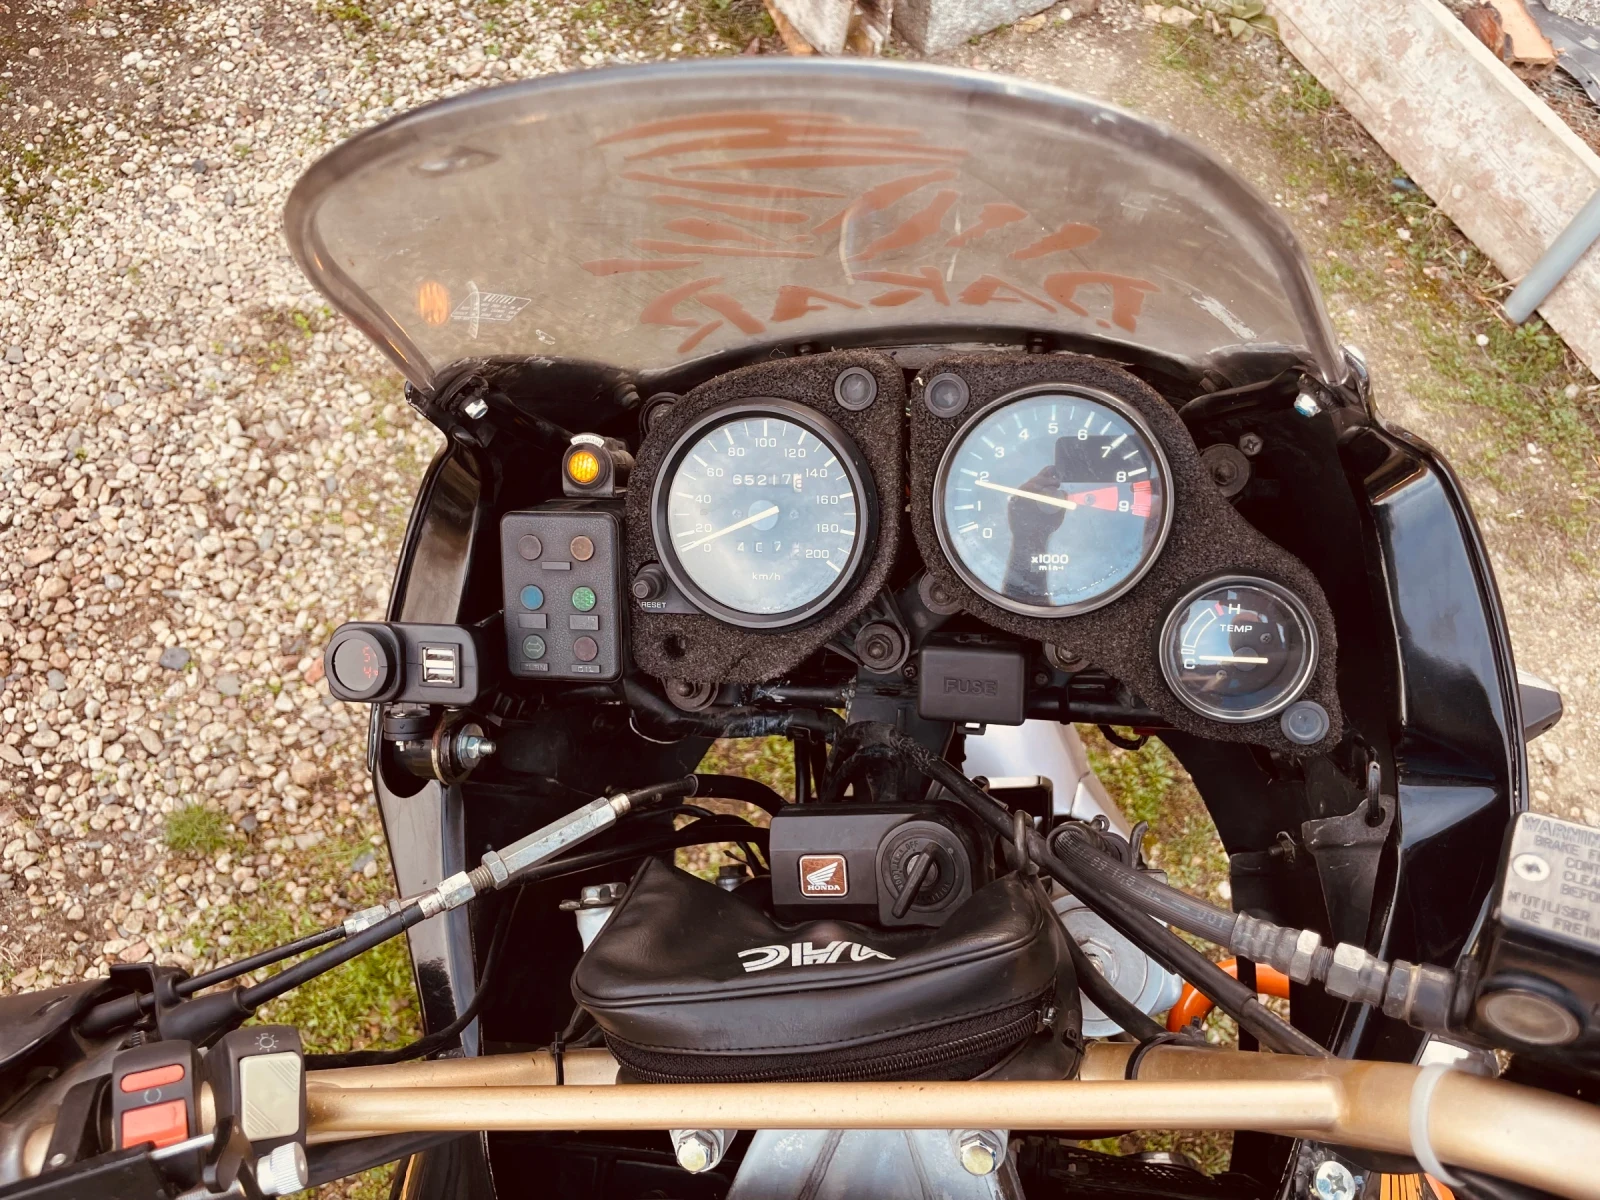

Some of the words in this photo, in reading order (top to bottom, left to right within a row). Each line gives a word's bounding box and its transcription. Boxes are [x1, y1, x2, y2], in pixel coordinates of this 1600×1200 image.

[1048, 423, 1058, 434] 5
[1018, 429, 1029, 440] 4
[1077, 429, 1088, 441] 6
[755, 437, 777, 448] 100
[727, 447, 745, 457] 80
[784, 448, 806, 458] 120
[994, 446, 1005, 458] 3
[1101, 446, 1112, 458] 7
[706, 468, 724, 478] 60
[805, 468, 828, 478] 140
[979, 471, 990, 482] 2
[1115, 471, 1127, 483] 8
[695, 495, 712, 504] 40
[816, 495, 838, 505] 160
[976, 501, 982, 512] 1
[1118, 500, 1130, 512] 9
[695, 523, 713, 533] 20
[816, 524, 839, 533] 180
[983, 528, 993, 539] 0
[703, 543, 712, 553] 0
[805, 549, 830, 559] 200
[1030, 554, 1069, 565] x1000
[752, 572, 781, 581] km/h
[641, 601, 667, 609] RESET
[1228, 603, 1241, 615] H
[1219, 623, 1253, 633] TEMP
[1183, 658, 1196, 670] C
[944, 677, 998, 696] FUSE
[905, 840, 919, 850] OFF
[1534, 835, 1580, 857] BRAKE
[1520, 908, 1541, 924] DE
